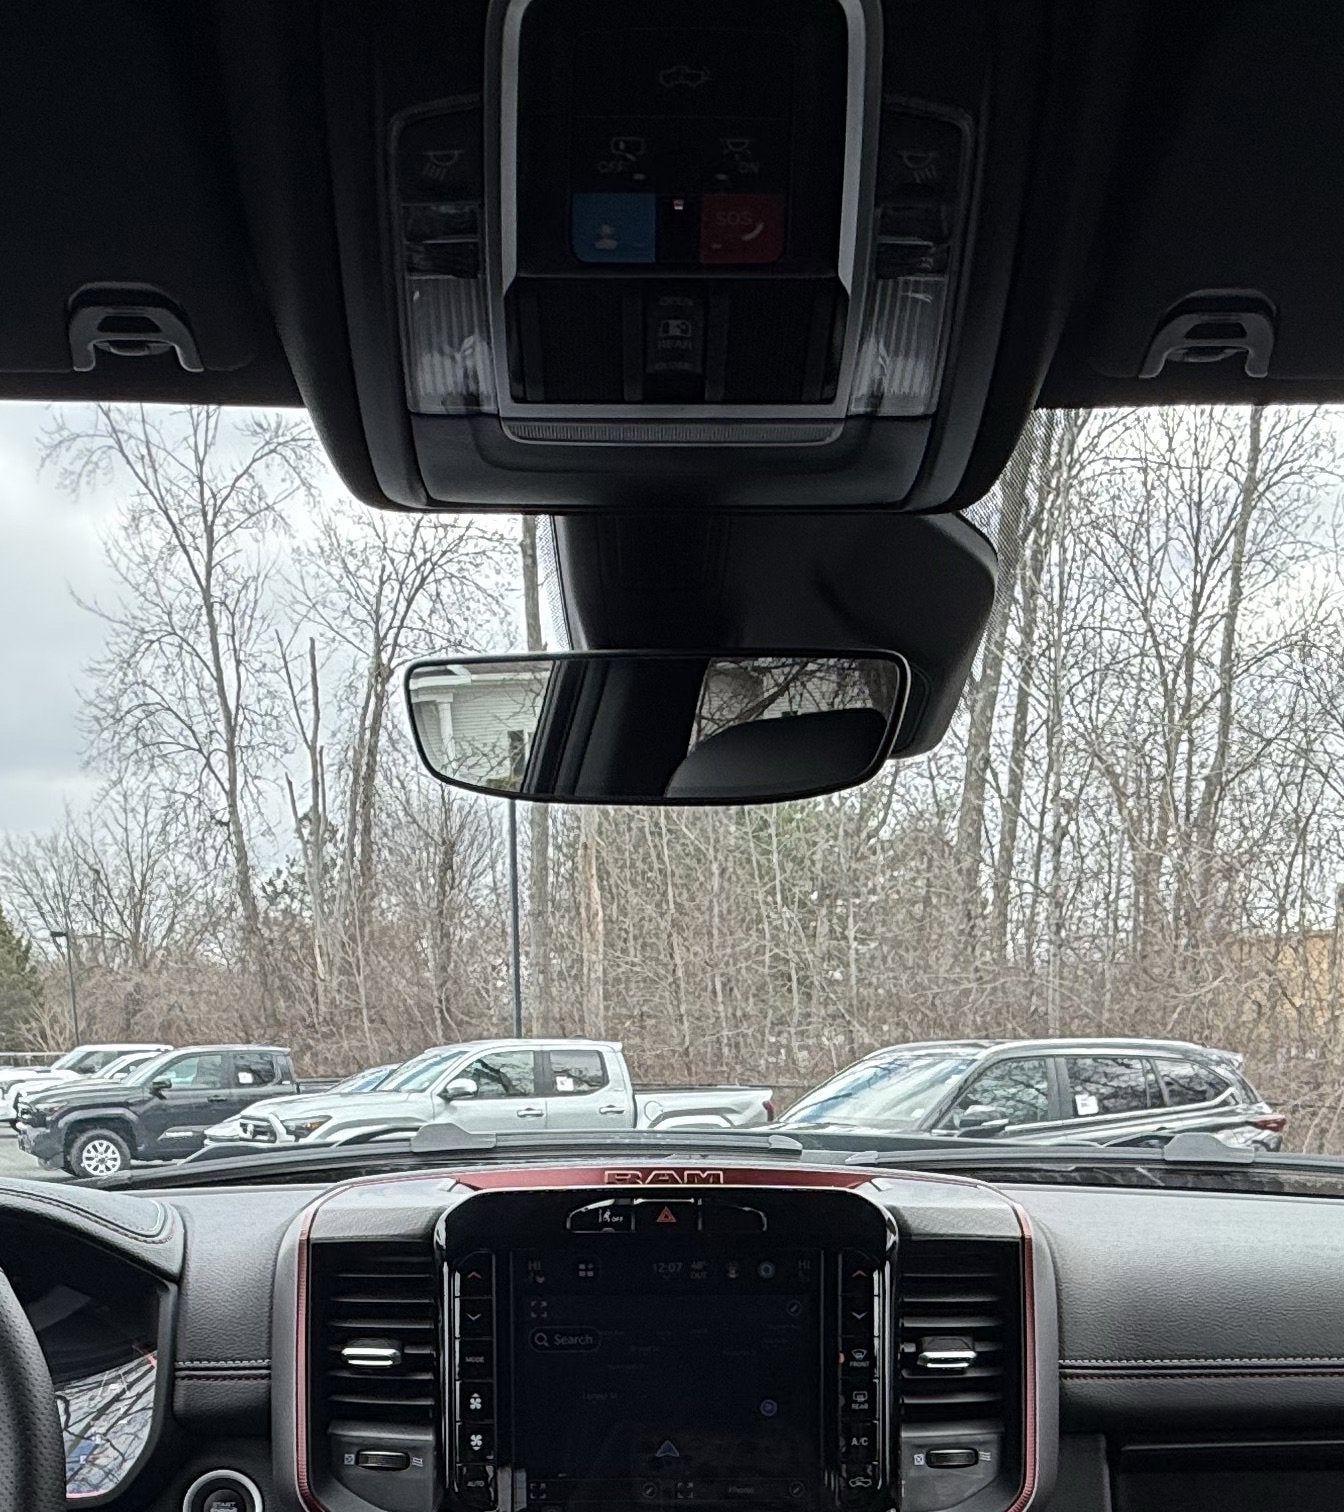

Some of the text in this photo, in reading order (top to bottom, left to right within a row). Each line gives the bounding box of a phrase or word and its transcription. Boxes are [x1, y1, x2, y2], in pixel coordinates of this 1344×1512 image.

[716, 211, 753, 226] SOS
[604, 1169, 724, 1185] RAM
[652, 1262, 683, 1273] 12:07
[553, 1333, 594, 1346] Search
[850, 1436, 869, 1447] A/C
